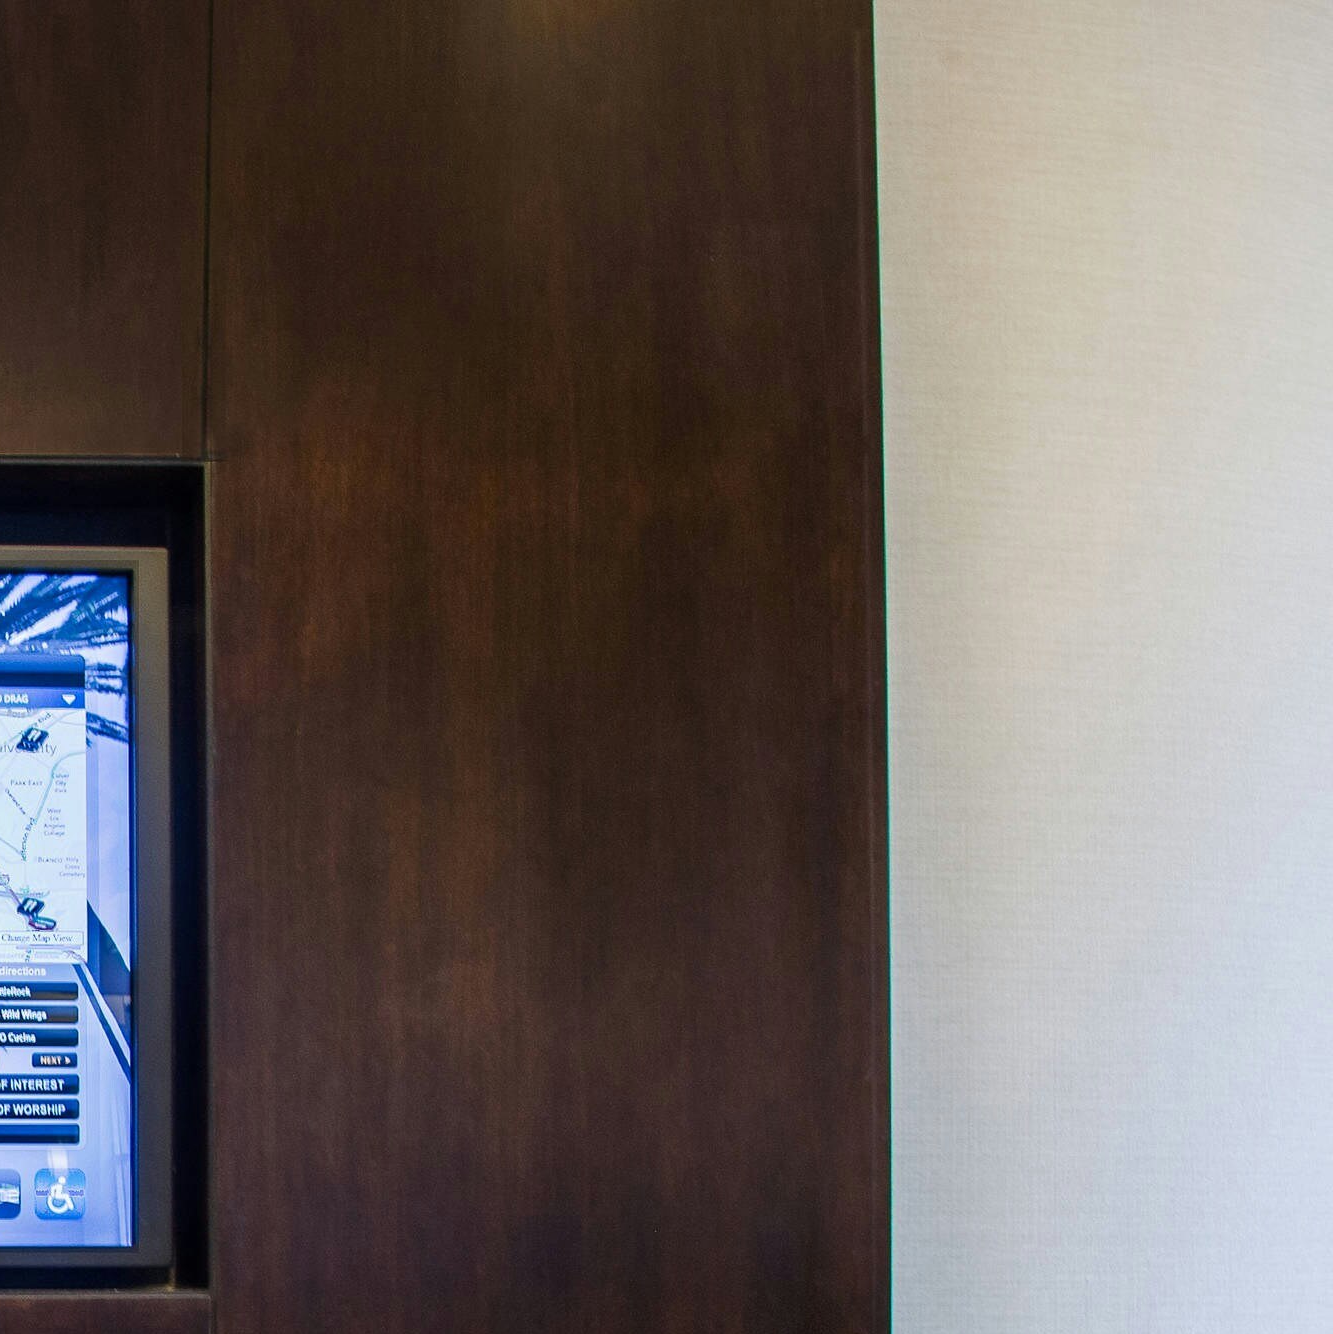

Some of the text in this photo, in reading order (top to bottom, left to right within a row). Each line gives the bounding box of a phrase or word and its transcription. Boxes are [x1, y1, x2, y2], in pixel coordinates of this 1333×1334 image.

[4, 693, 29, 704] DRAG
[0, 966, 46, 976] directions
[40, 1055, 61, 1065] NEXT
[11, 1078, 64, 1091] INTEREST
[13, 1103, 66, 1116] WORSHIP
